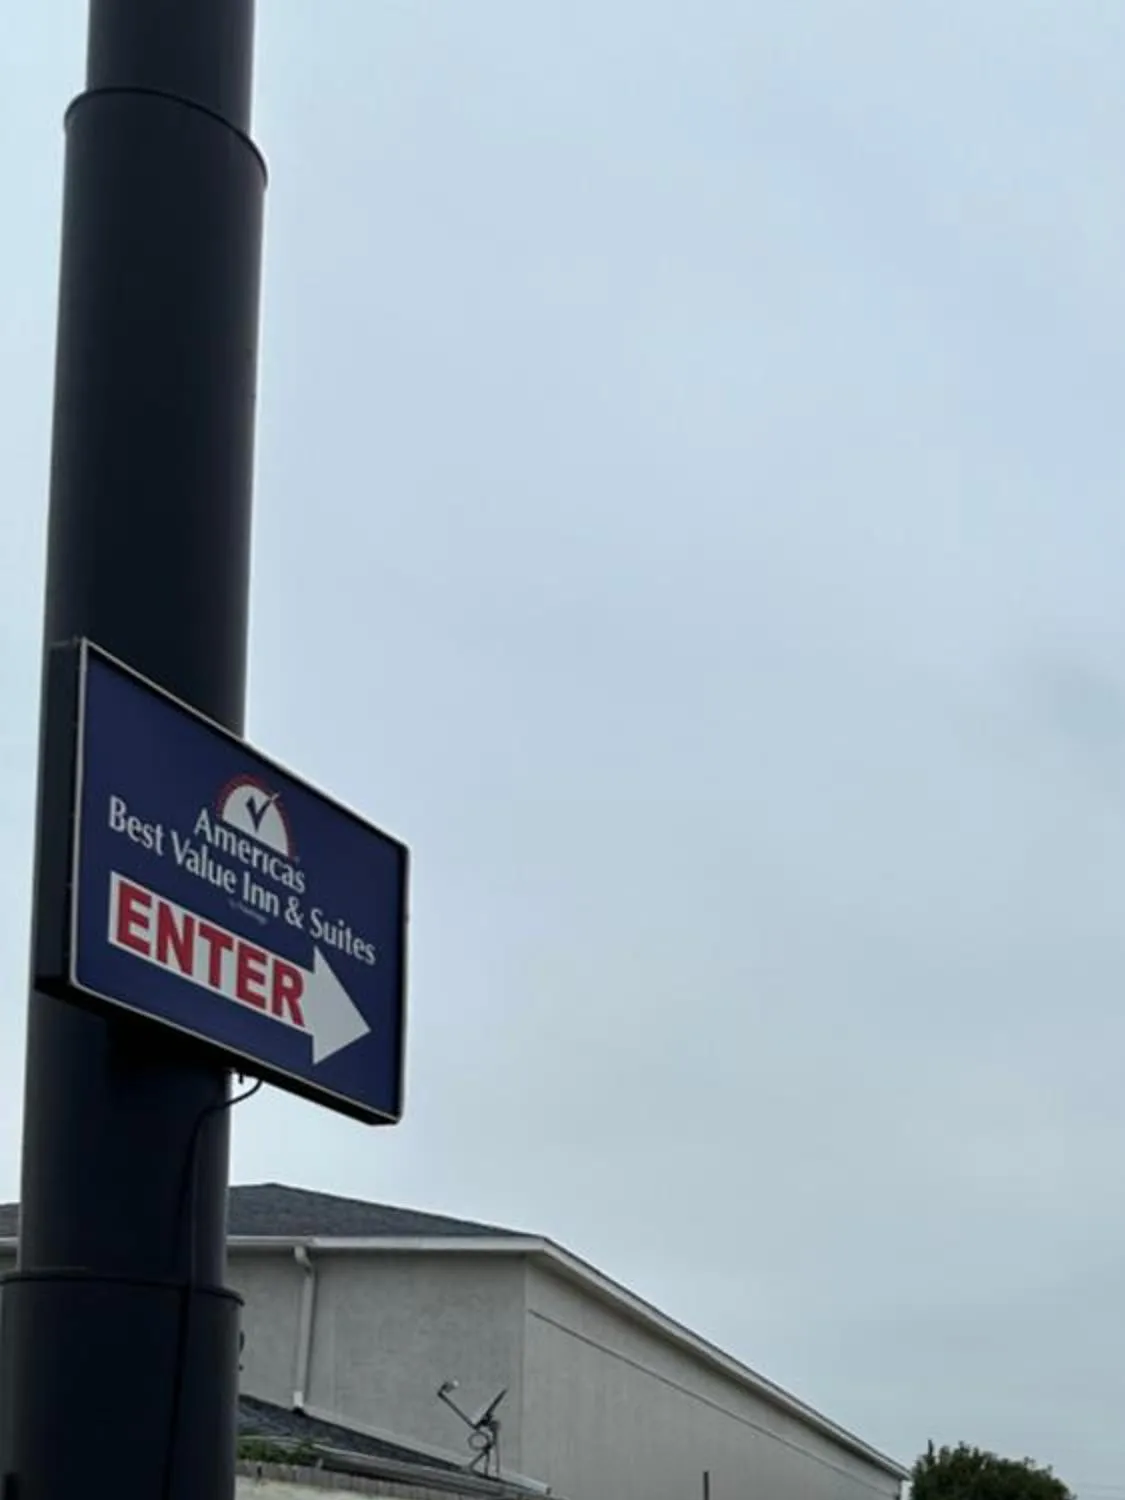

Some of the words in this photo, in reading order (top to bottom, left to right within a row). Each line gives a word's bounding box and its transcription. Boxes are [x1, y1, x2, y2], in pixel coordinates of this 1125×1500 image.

[109, 795, 164, 857] Best
[170, 829, 238, 895] Value
[242, 871, 280, 918] Inn
[284, 896, 305, 929] &
[309, 907, 377, 967] Suites
[194, 807, 306, 893] Americas
[116, 879, 306, 1028] ENTER
